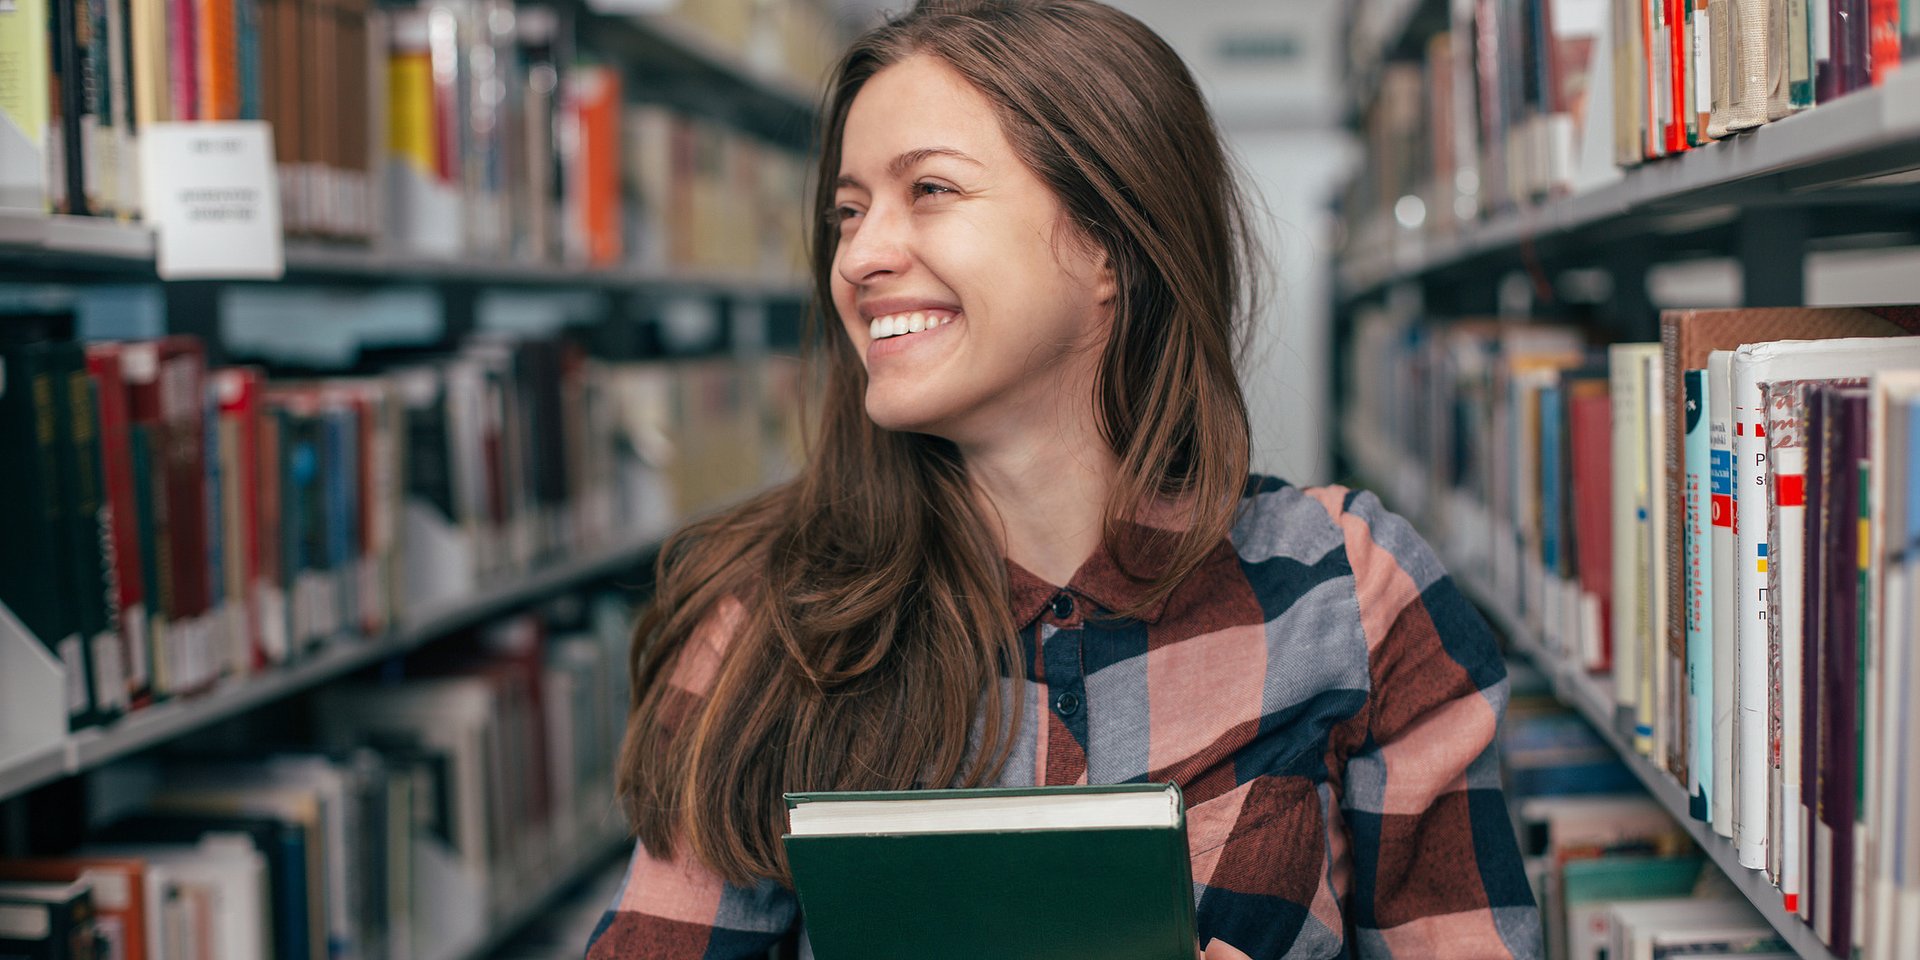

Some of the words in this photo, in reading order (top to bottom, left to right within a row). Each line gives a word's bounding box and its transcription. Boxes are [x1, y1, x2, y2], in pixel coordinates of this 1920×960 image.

[1756, 454, 1766, 467] P
[1692, 473, 1703, 633] rosyjsko-polski
[1758, 588, 1767, 601] П
[1758, 611, 1766, 620] п
